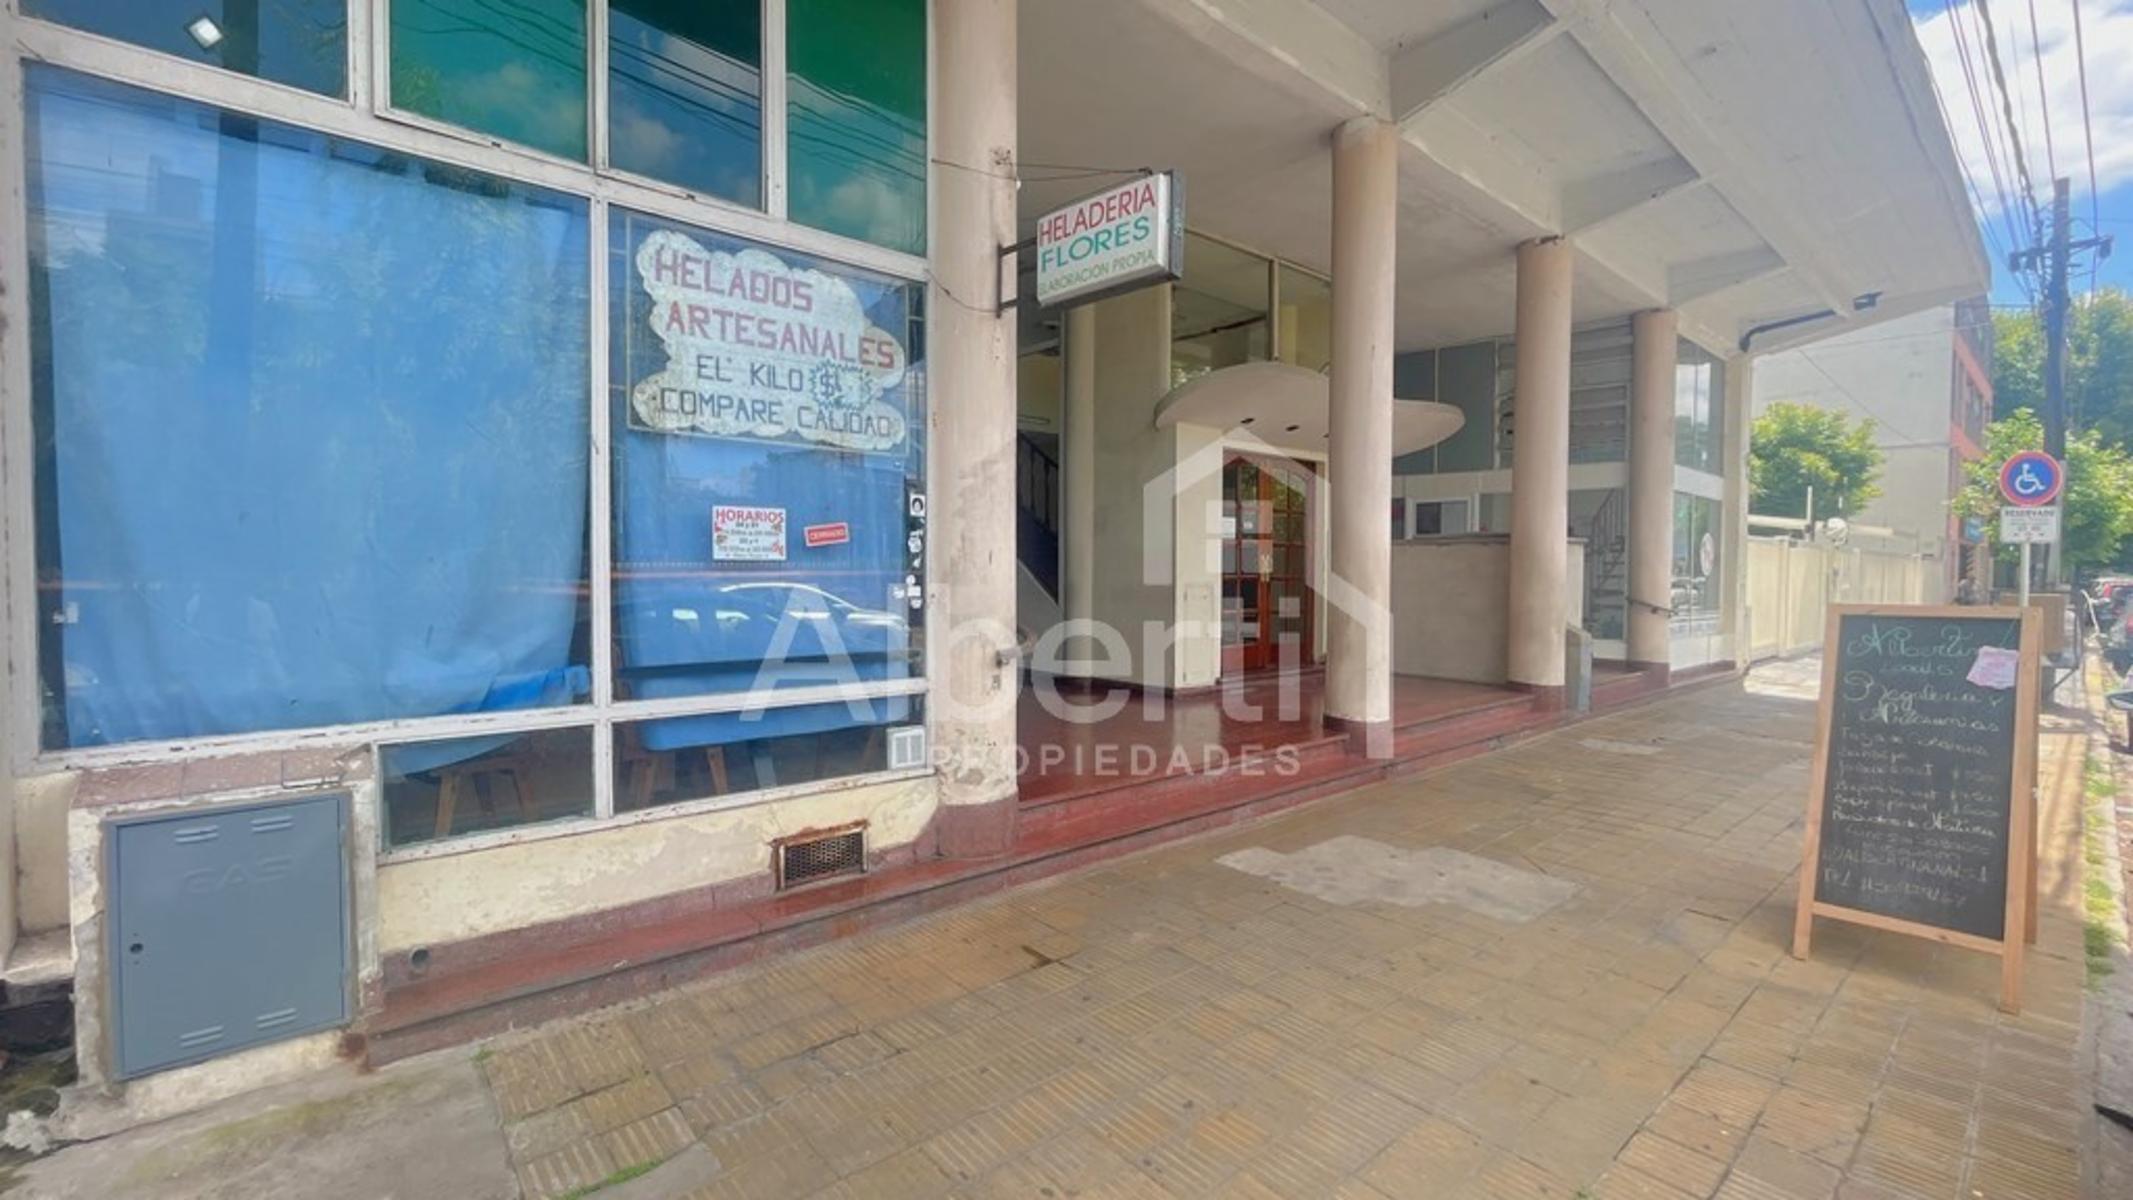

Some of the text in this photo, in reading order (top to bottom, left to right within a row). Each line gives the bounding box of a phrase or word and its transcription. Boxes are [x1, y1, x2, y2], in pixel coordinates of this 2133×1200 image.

[1039, 184, 1155, 246] HELADERIA
[1041, 216, 1149, 272] FLORES
[653, 245, 813, 313] HELADOS
[666, 301, 895, 369] ARTESANALES
[697, 354, 732, 383] EL
[751, 362, 804, 392] KILO
[660, 387, 893, 438] COMPARE CALIDAD
[716, 508, 784, 524] HORARIOS
